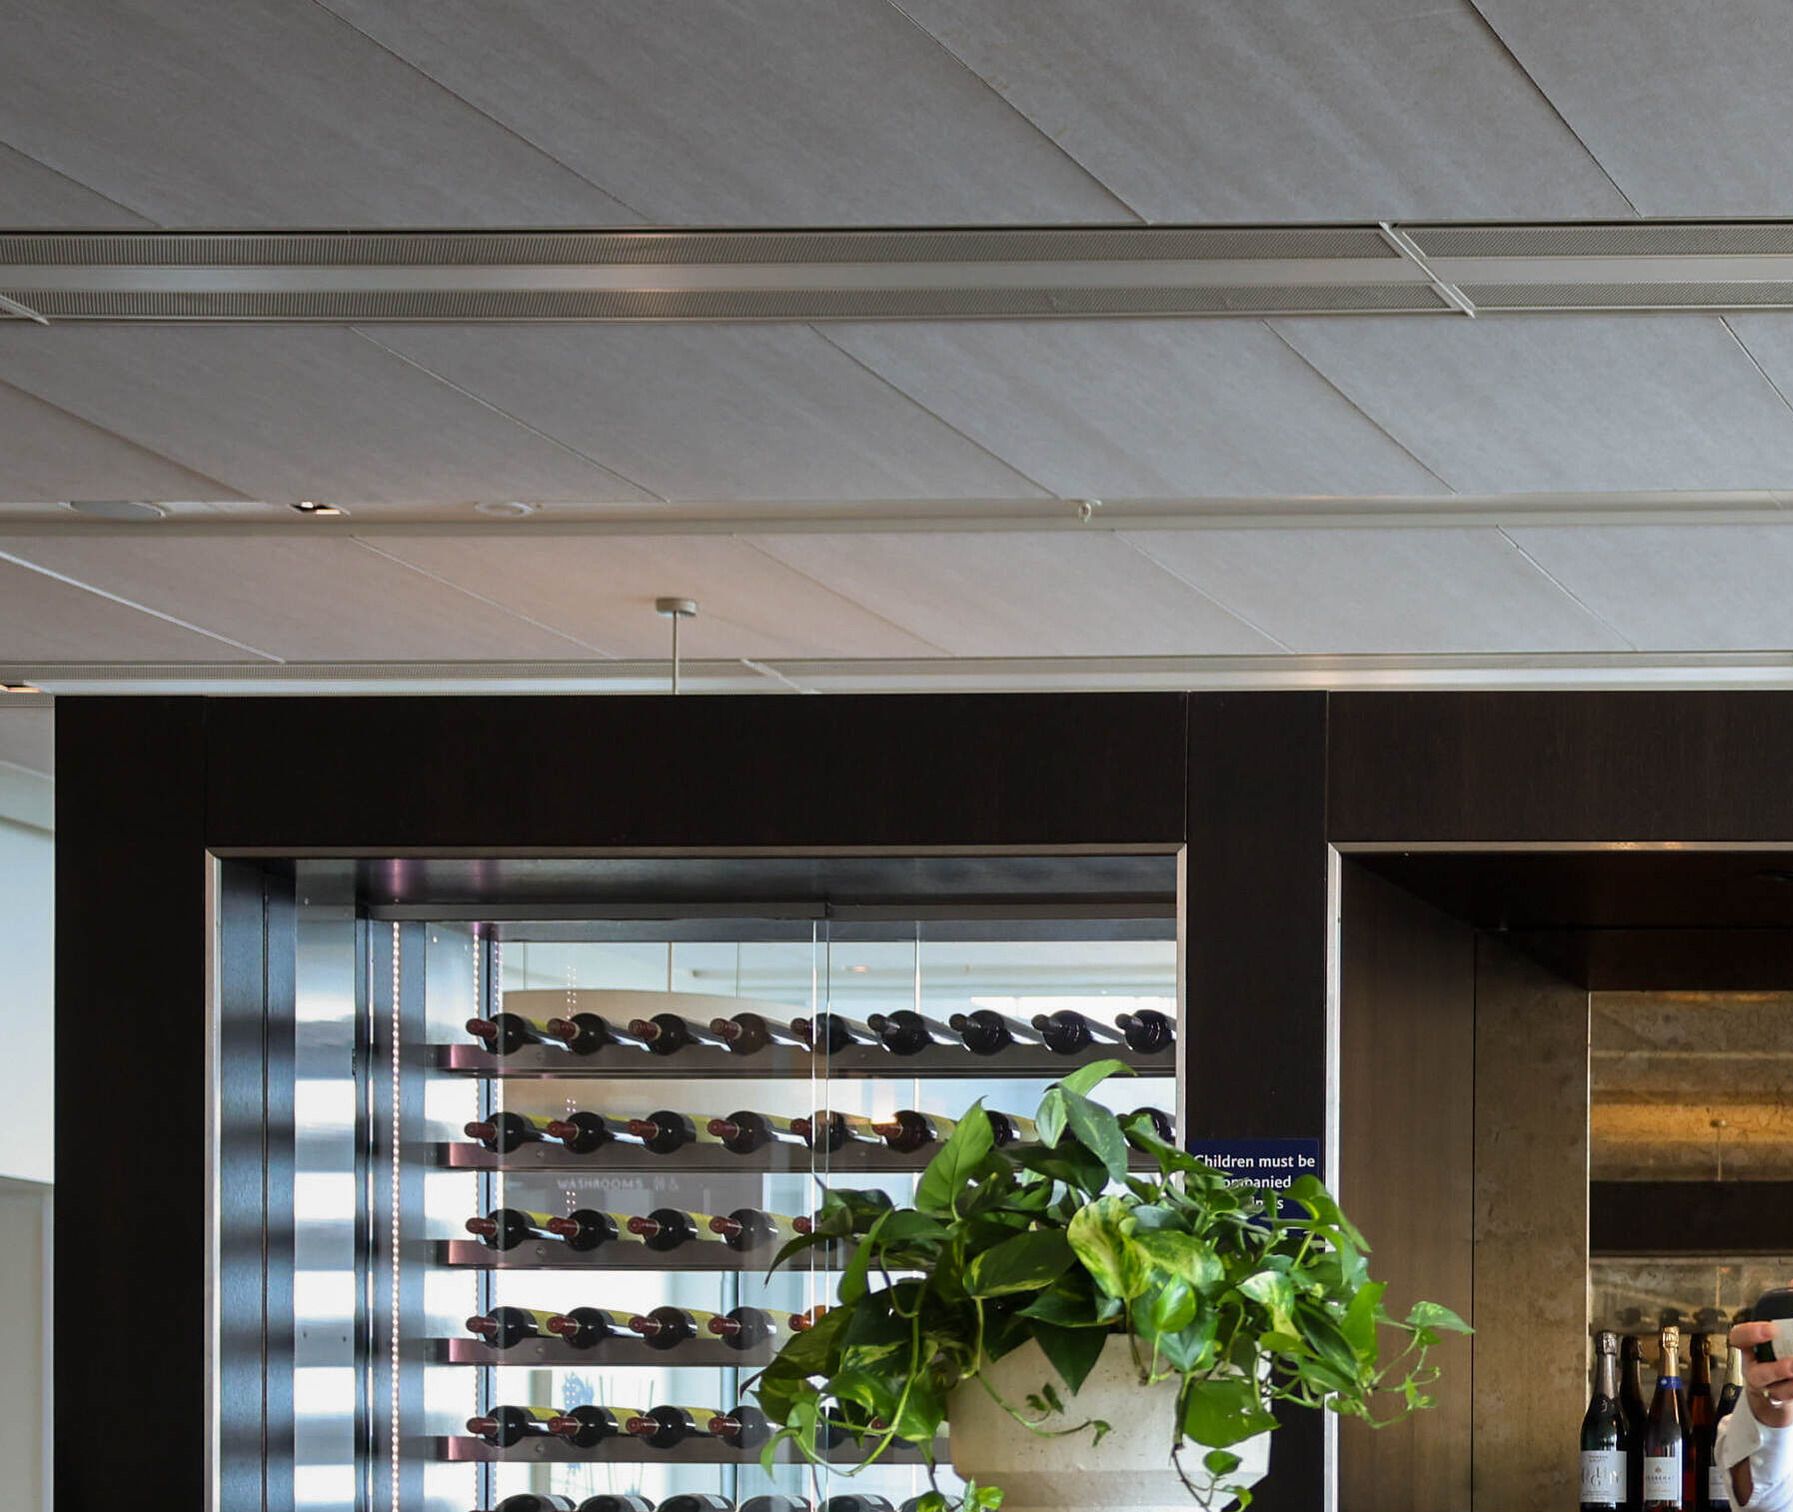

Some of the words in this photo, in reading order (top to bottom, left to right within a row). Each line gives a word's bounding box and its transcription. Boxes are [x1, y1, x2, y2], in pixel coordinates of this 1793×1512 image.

[1259, 1156, 1294, 1168] must
[1298, 1154, 1316, 1168] be
[557, 1176, 644, 1191] WASHROOMS
